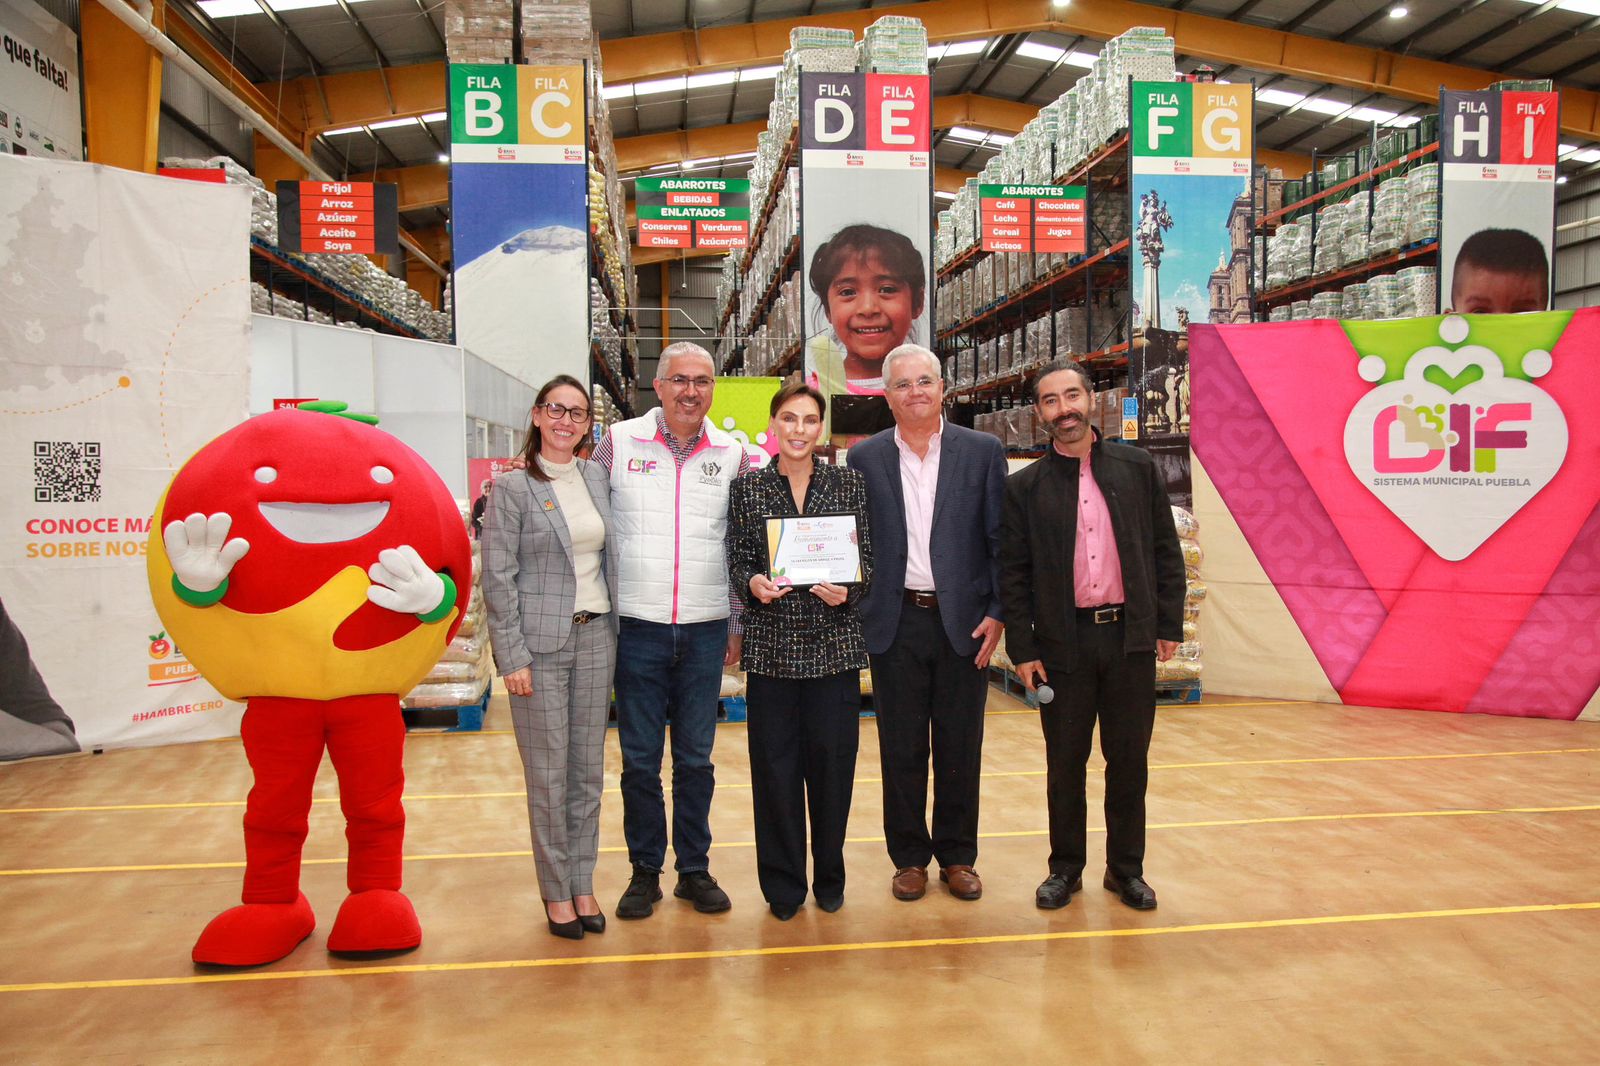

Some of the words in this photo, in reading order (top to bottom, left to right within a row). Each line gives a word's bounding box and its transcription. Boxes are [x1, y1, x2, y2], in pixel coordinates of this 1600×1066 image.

[4, 35, 31, 67] que
[33, 49, 68, 92] falta!
[467, 76, 501, 88] FILA
[535, 78, 568, 90] FILA
[818, 84, 852, 96] FILA
[882, 86, 914, 98] FILA
[1148, 93, 1179, 105] FILA
[1208, 95, 1238, 107] FILA
[464, 91, 504, 136] B
[1458, 102, 1488, 114] FILA
[1516, 103, 1546, 115] FILA
[530, 92, 572, 138] C
[814, 98, 854, 142] D
[881, 100, 916, 144] E
[1148, 107, 1179, 150] F
[1201, 108, 1241, 152] G
[1453, 114, 1489, 158] H
[1524, 116, 1534, 158] I
[322, 184, 352, 194] Frijol
[660, 180, 726, 190] ABARROTES
[1002, 186, 1064, 196] ABARROTES
[321, 199, 354, 208] Arroz
[674, 196, 712, 204] BEBIDAS
[996, 200, 1016, 208] Café
[317, 212, 358, 222] Azúcar
[660, 208, 726, 217] ENLATADOS
[994, 214, 1018, 222] Leche
[642, 222, 688, 230] Conservas
[702, 224, 742, 232] Verduras
[992, 228, 1020, 236] Cereal
[320, 228, 356, 238] Aceite
[1048, 228, 1072, 237] Jugos
[324, 241, 352, 251] Soya
[652, 237, 678, 245] Chiles
[699, 238, 746, 246] Azúcar/Sal
[990, 241, 1022, 250] Lácteos
[1373, 402, 1532, 474] DIF
[1374, 477, 1420, 486] SISTEMA
[1422, 477, 1484, 487] MUNICIPAL
[1486, 478, 1532, 488] PUEBLA
[26, 518, 118, 534] CONOCE
[26, 542, 100, 558] SOBRE
[132, 700, 224, 722] #HAMBRECERO
